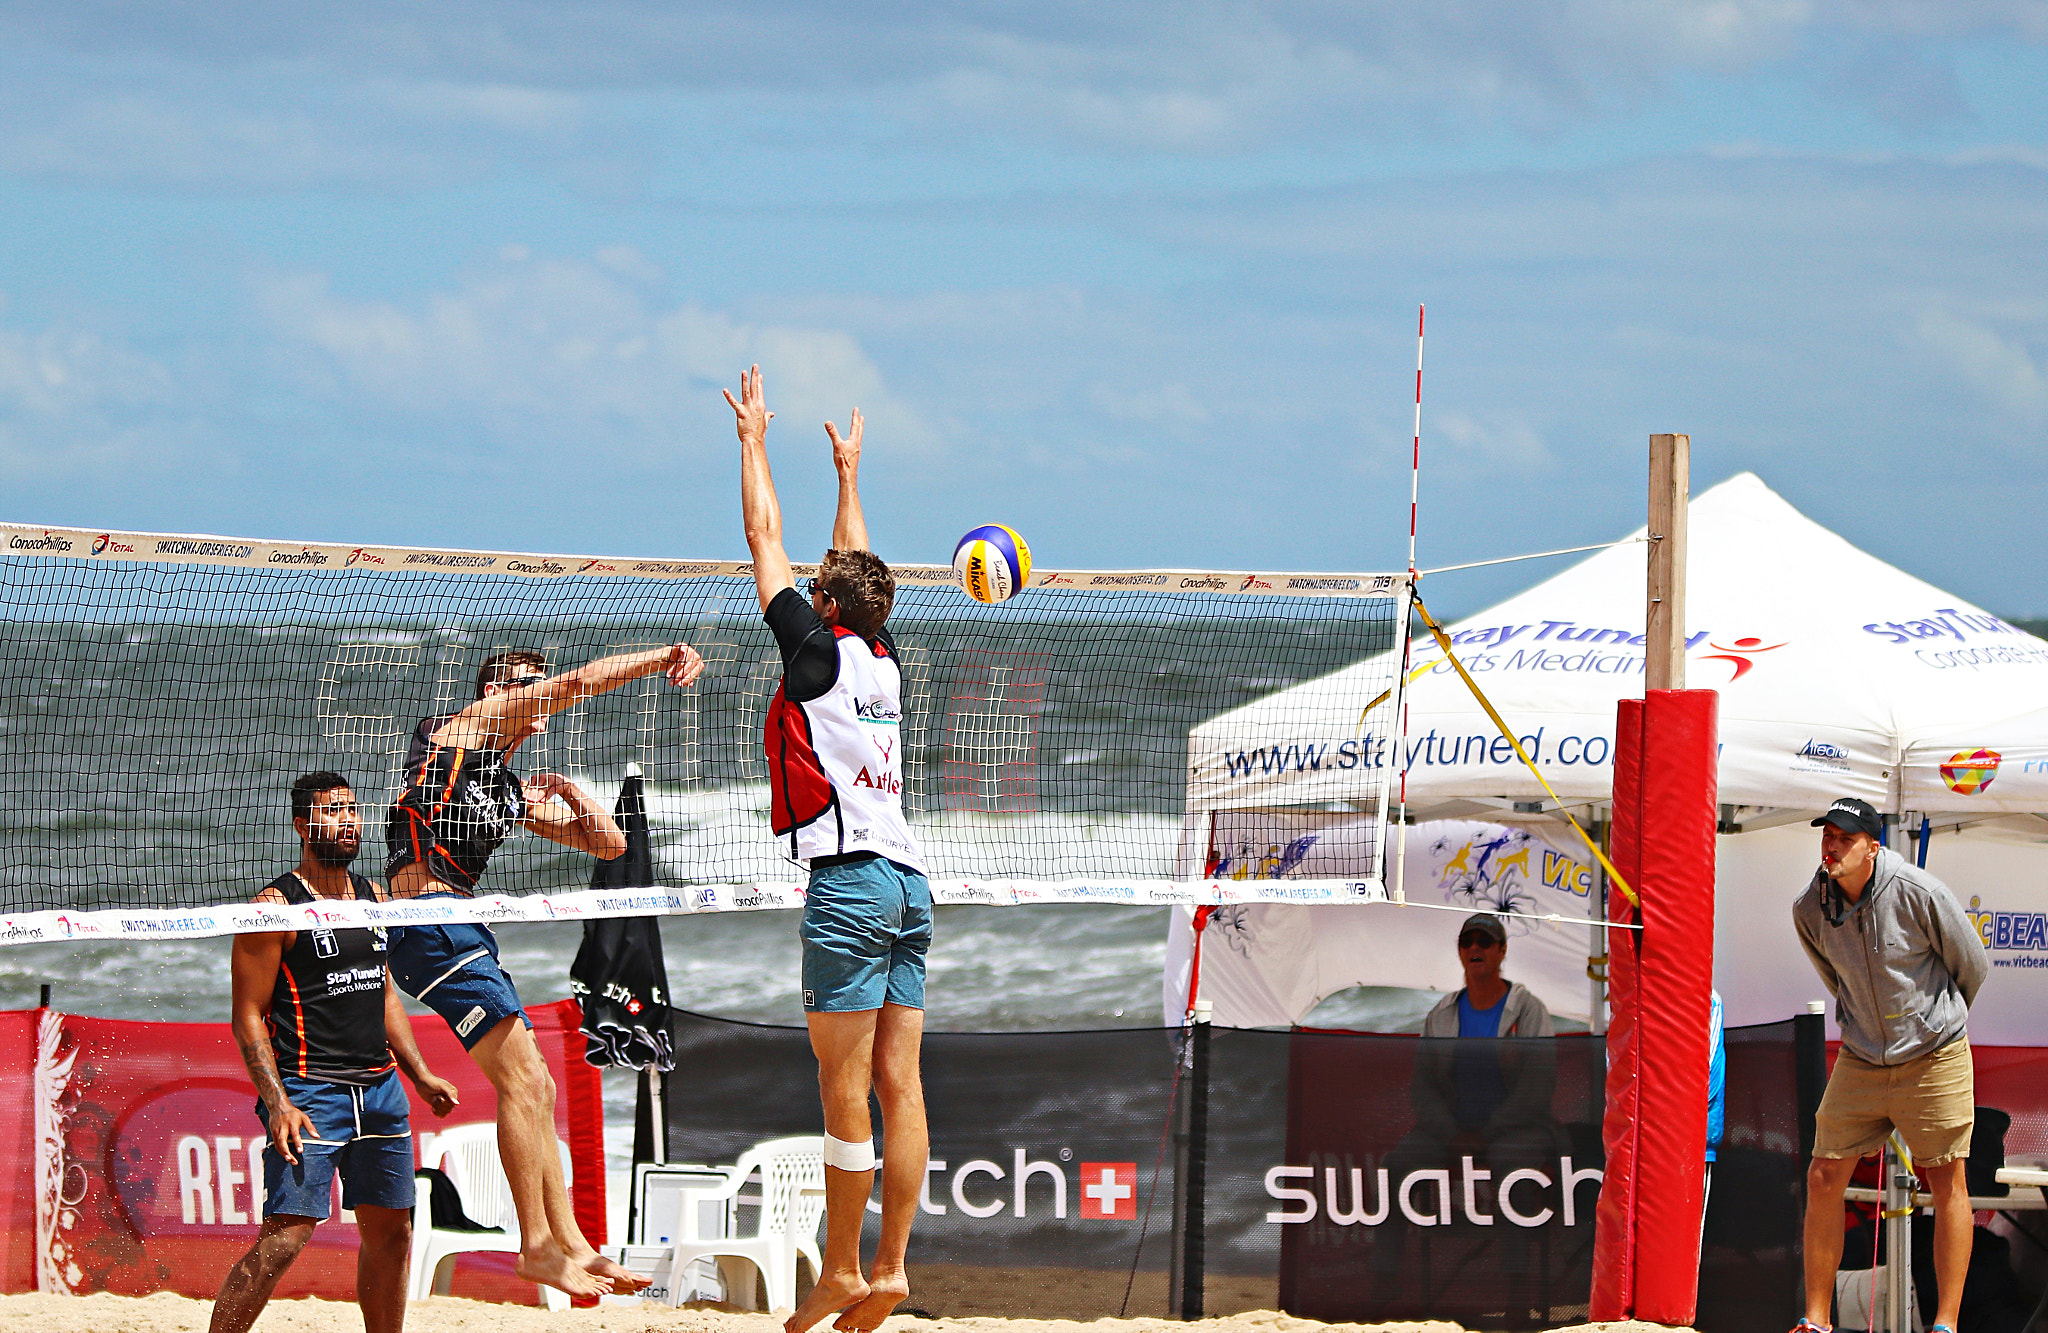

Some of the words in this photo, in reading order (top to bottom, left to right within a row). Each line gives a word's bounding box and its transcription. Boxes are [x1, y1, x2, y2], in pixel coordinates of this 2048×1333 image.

[9, 533, 73, 552] ConocoPhillips
[108, 541, 135, 553] TOTAL
[1503, 648, 1647, 675] Medicin
[1914, 645, 2026, 673] Corporate
[326, 964, 381, 986] StayTuned
[328, 983, 355, 997] Sports
[354, 980, 382, 992] Medicine
[1264, 1155, 1606, 1228] swatch
